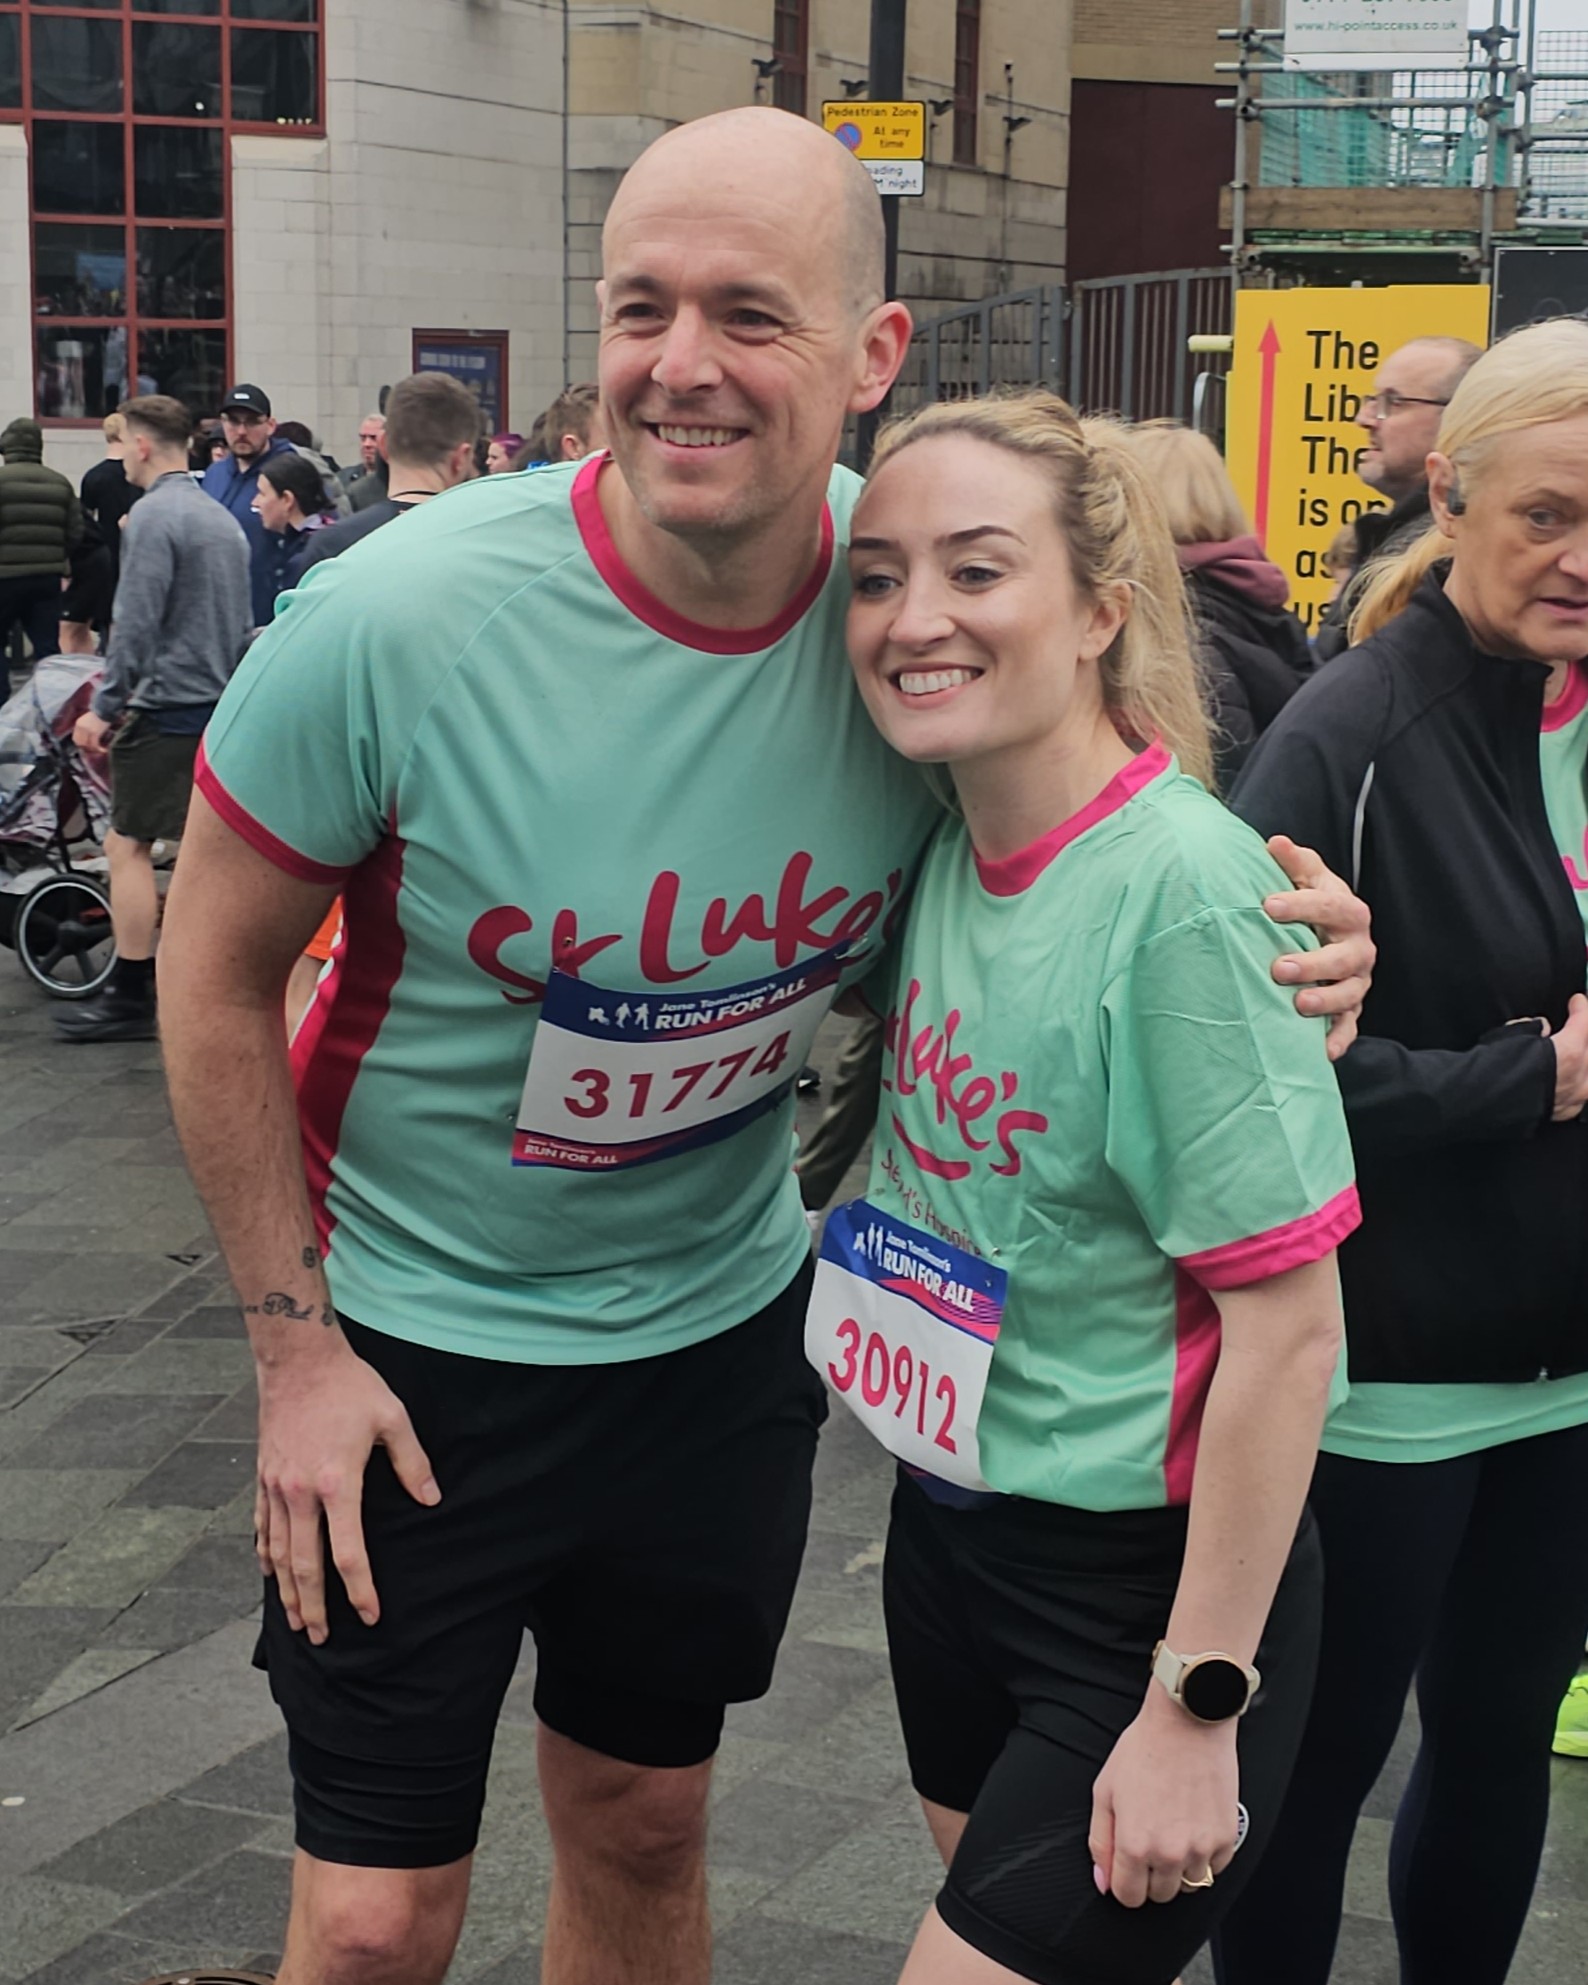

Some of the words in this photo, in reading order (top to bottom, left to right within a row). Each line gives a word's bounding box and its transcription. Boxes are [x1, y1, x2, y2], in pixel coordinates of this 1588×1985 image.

[1293, 21, 1458, 31] www.hi-pointaccess.co.uk
[827, 107, 887, 117] Pedestrian
[892, 107, 918, 117] Zone
[873, 127, 885, 136] At
[892, 128, 910, 137] any
[880, 140, 904, 148] time
[865, 166, 903, 177] oading
[1306, 330, 1380, 370] The
[1304, 382, 1361, 422] Lib
[1298, 488, 1328, 526] is
[654, 1009, 713, 1030] RUN
[716, 996, 766, 1021] FOR
[768, 977, 807, 1005] ALL
[659, 1003, 696, 1013] Jane
[700, 982, 777, 1009] Tomlinson's
[563, 1029, 792, 1119] 31774
[524, 1144, 558, 1158] RUN
[559, 1151, 590, 1163] FOR
[591, 1155, 619, 1164] ALL
[883, 1247, 917, 1282] RUN
[917, 1262, 943, 1297] FOR
[942, 1280, 975, 1313] ALL
[827, 1317, 958, 1456] 30912
